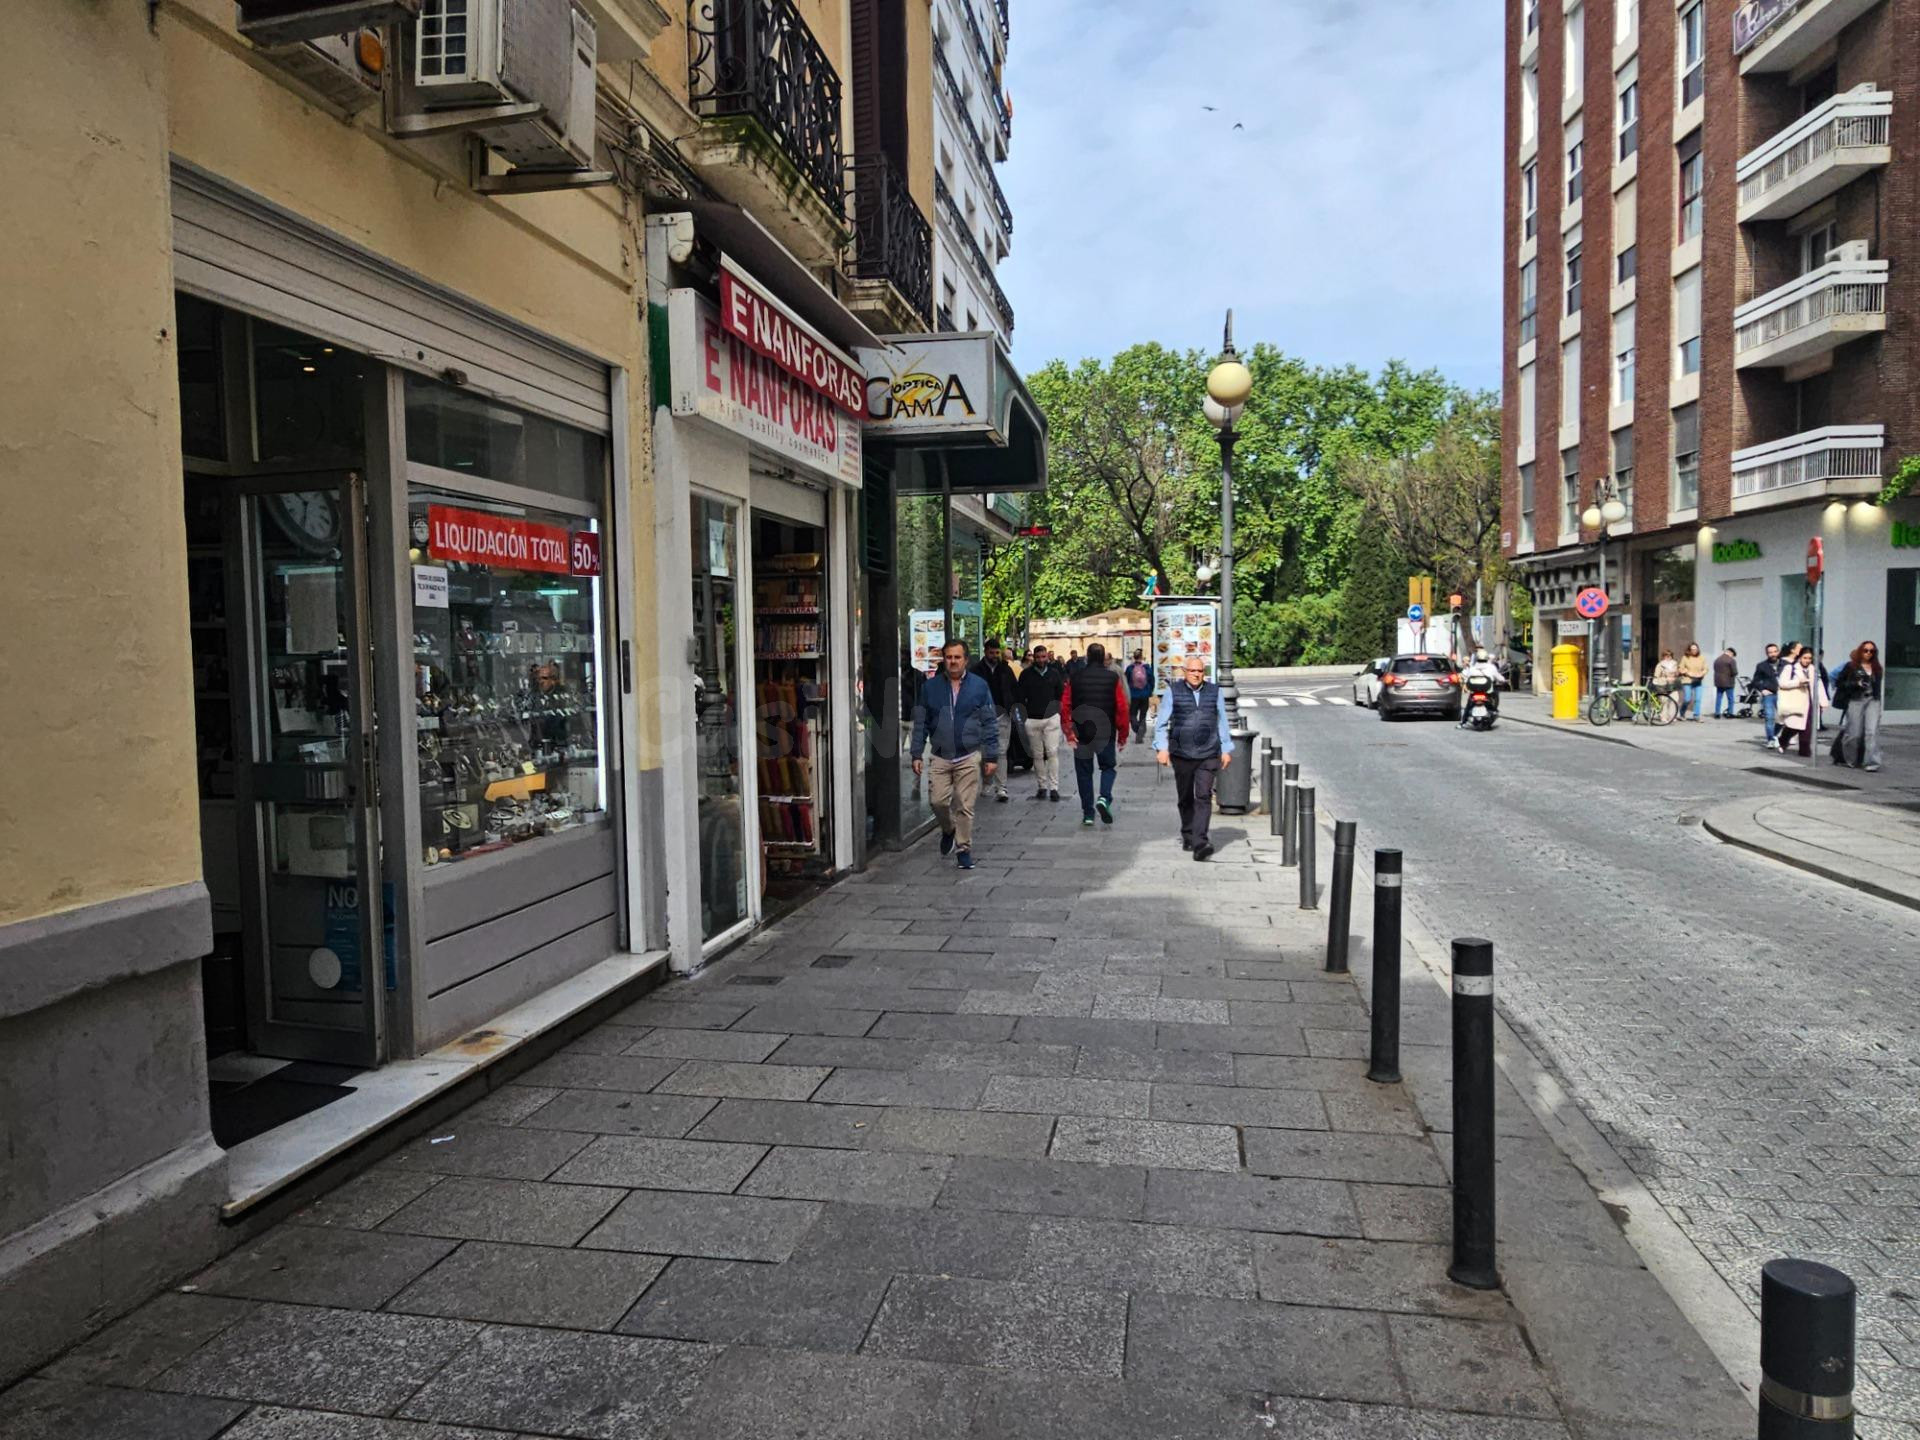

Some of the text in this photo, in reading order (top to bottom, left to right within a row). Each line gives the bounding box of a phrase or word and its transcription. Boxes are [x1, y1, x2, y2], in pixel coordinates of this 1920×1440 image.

[866, 373, 976, 421] GAMA
[891, 379, 943, 394] OPTICA
[719, 399, 744, 423] high
[750, 417, 784, 445] quality
[789, 437, 829, 464] cosmetics
[435, 521, 567, 564] LIQUIDACIÓN TOTAL
